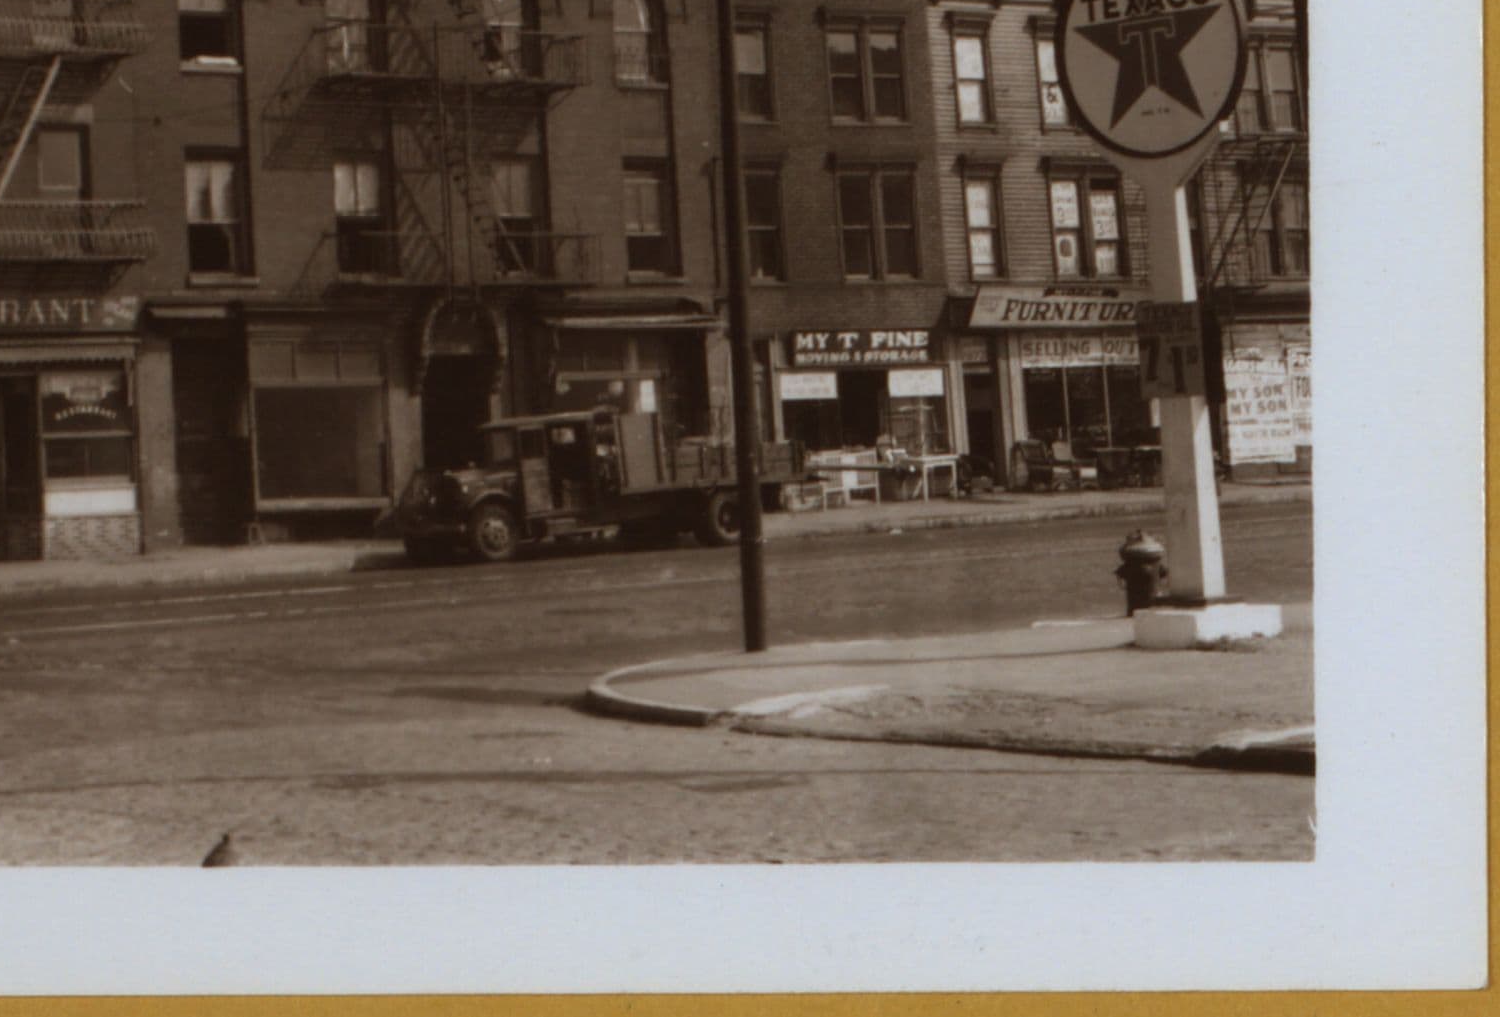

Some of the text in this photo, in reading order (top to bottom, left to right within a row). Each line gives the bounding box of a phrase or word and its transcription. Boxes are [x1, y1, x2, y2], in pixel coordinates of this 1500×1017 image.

[795, 331, 830, 351] MY
[1022, 339, 1136, 357] SELLING OUT
[795, 351, 851, 364] MOVING
[863, 349, 929, 363] STORAGE
[1254, 384, 1284, 399] SON
[1257, 400, 1288, 414] SON
